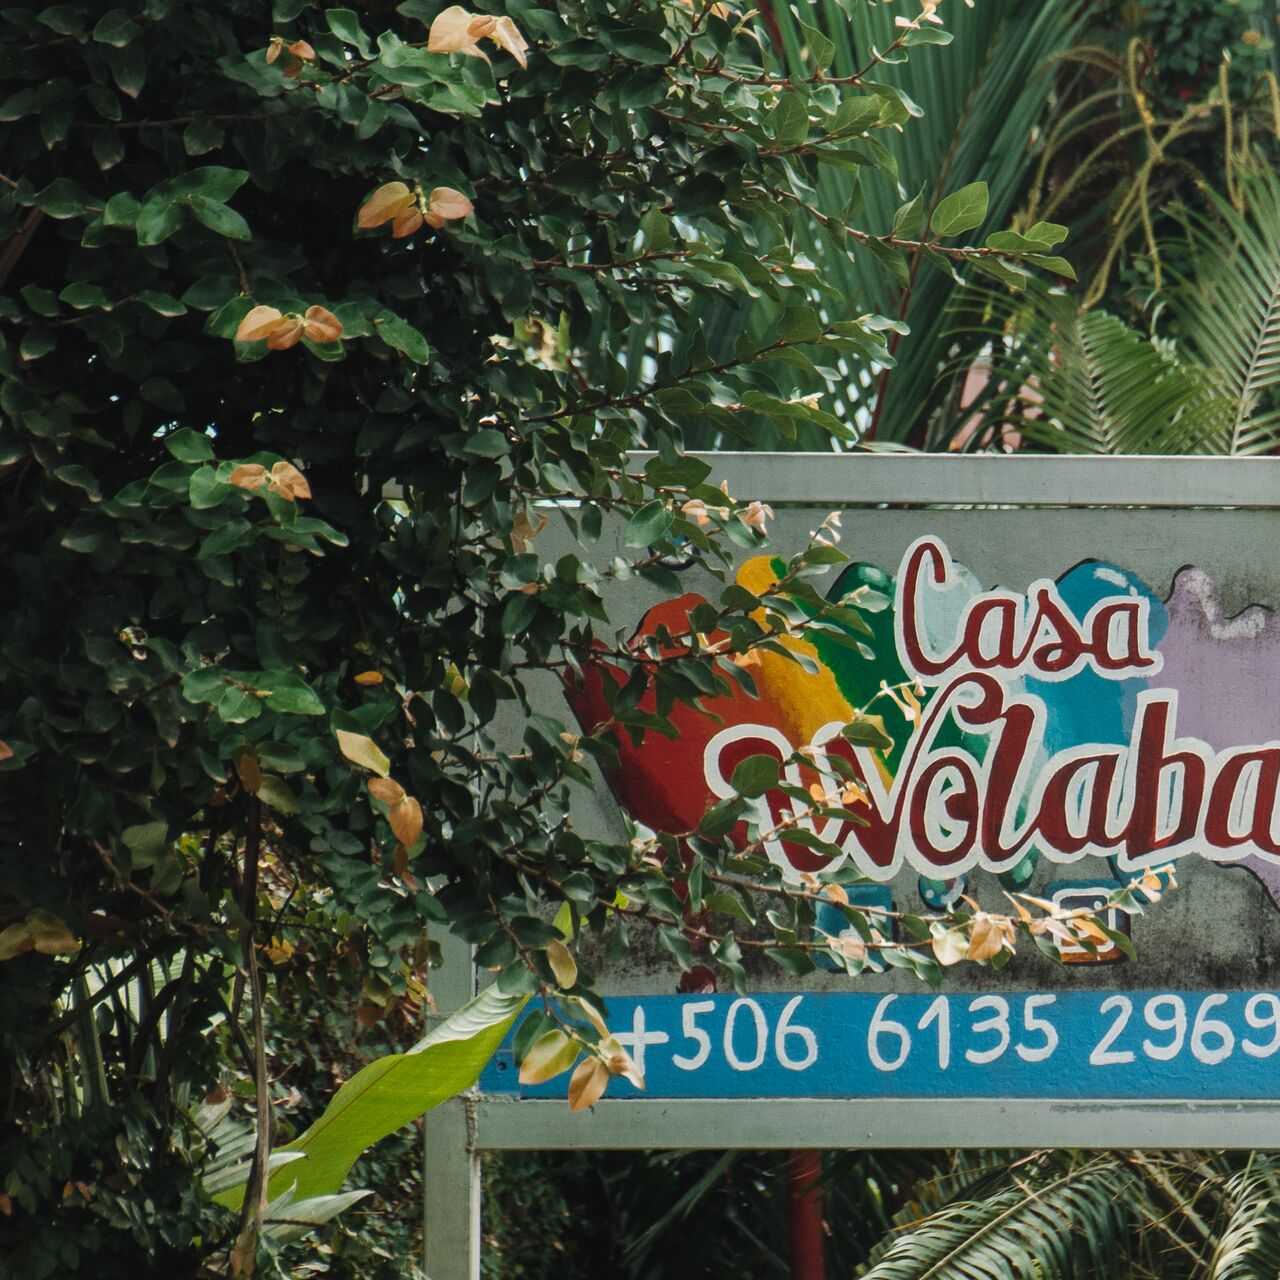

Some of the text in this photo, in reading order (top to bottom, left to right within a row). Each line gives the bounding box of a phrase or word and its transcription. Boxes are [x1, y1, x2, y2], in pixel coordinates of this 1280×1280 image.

[900, 540, 1157, 678] Casa
[607, 994, 819, 1072] +506
[866, 993, 1060, 1072] 6135
